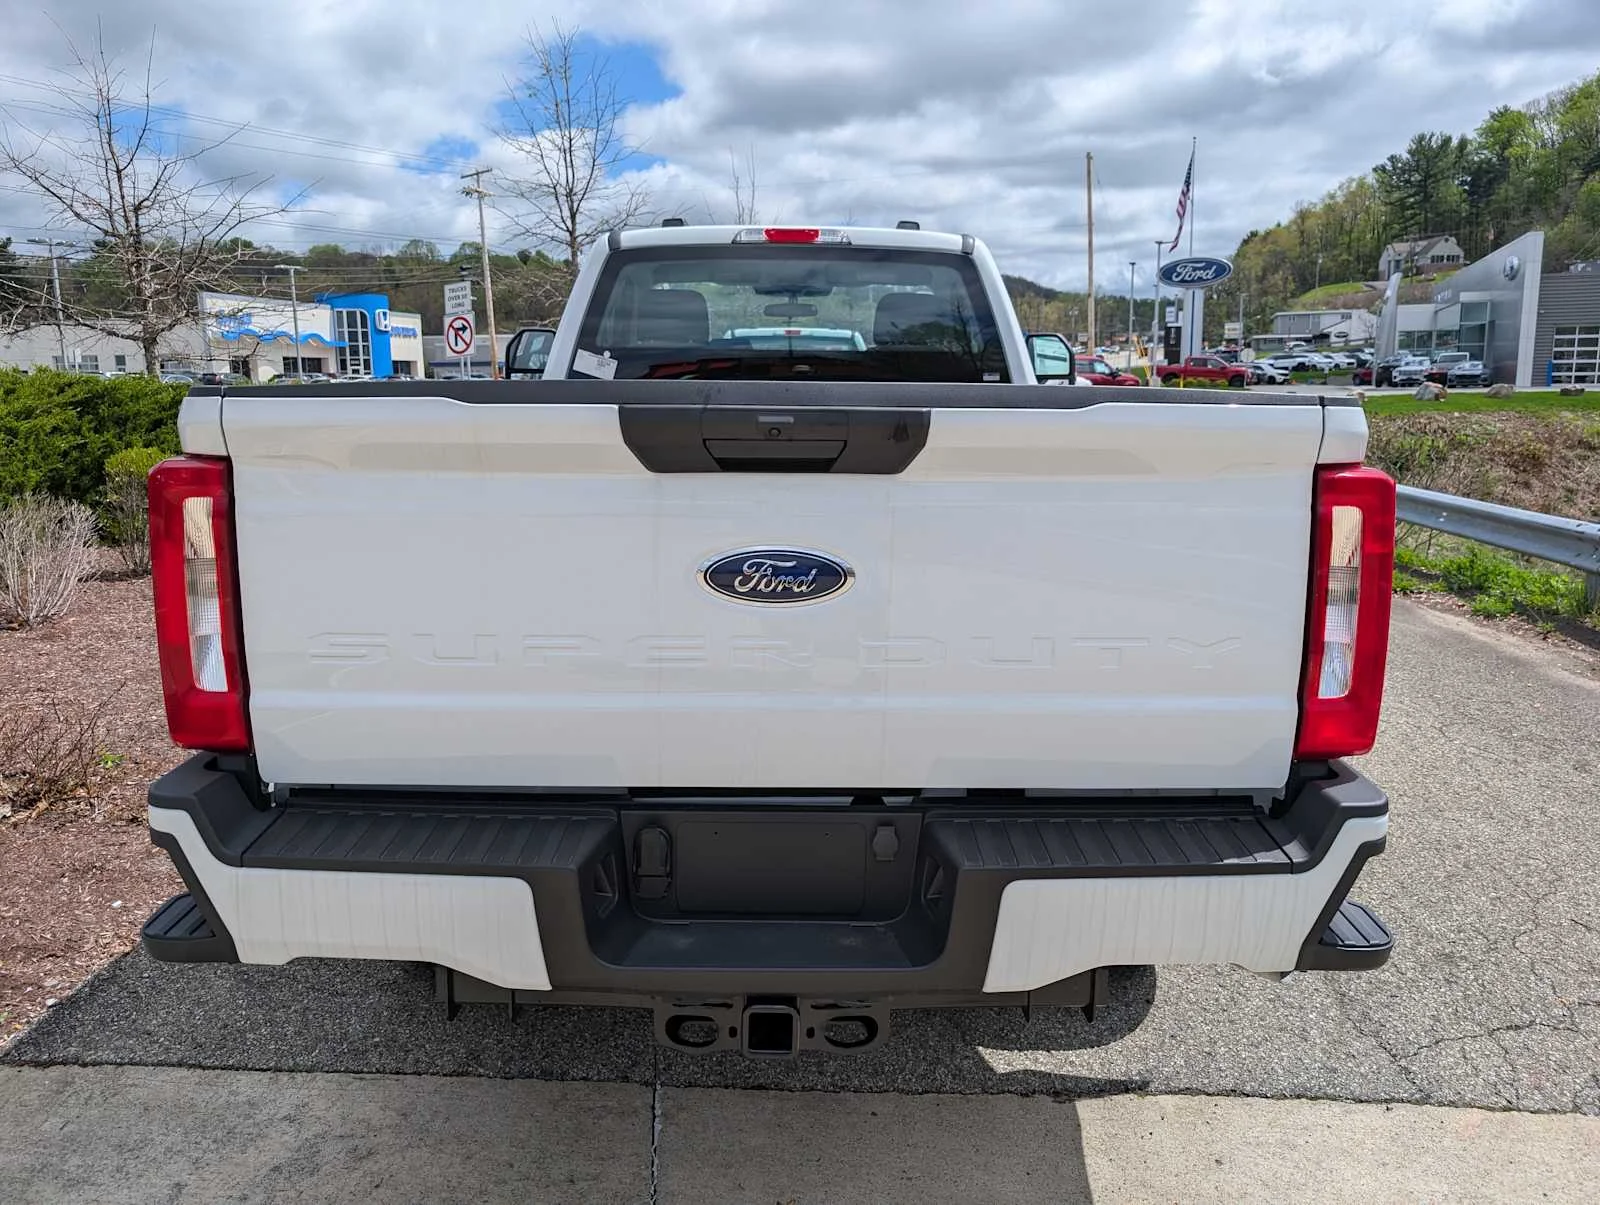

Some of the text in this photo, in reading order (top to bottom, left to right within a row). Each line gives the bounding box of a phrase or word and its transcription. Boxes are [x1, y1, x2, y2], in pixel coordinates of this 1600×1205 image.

[1172, 262, 1217, 282] Ford
[733, 558, 818, 593] Ford
[306, 632, 1242, 670] SUPER DUTY
